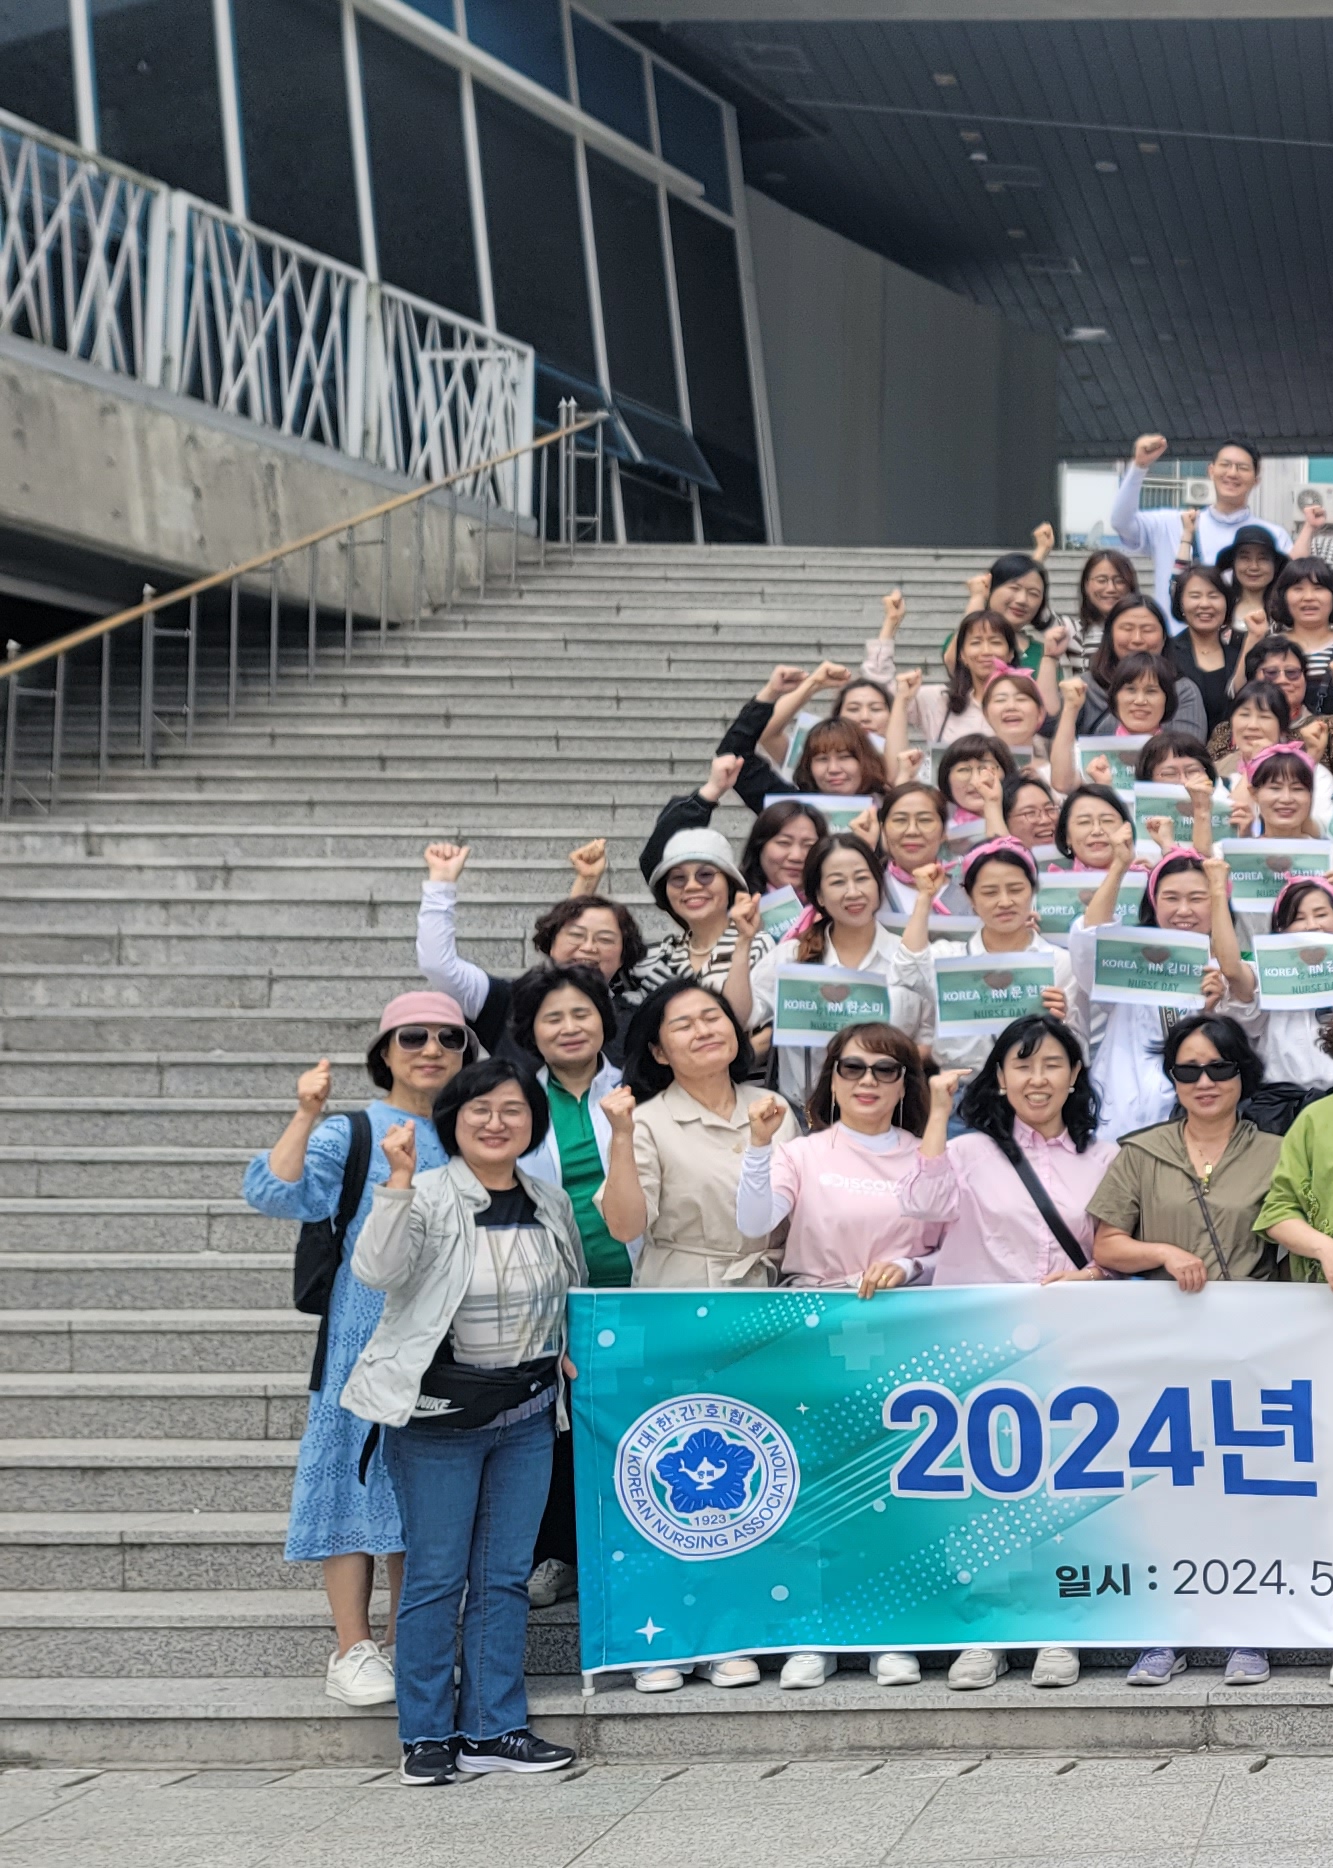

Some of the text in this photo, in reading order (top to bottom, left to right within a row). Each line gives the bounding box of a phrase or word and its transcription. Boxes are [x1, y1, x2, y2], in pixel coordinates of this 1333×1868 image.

[1230, 872, 1264, 880] KOREA
[1041, 905, 1076, 915] KOREA
[1101, 959, 1138, 970] KOREA
[1148, 962, 1164, 973] RN
[1264, 966, 1300, 977] KOREA
[1308, 964, 1324, 974] RN
[943, 990, 981, 1002] KOREA
[991, 987, 1008, 999] RN
[783, 999, 818, 1011] KOREA
[827, 1001, 844, 1013] RN
[417, 1395, 451, 1411] NIKE
[637, 1404, 767, 1449] 대한간호협회
[885, 1378, 1319, 1498] 2024년
[627, 1444, 788, 1549] KOREAN NURSING ASSOCIATION
[694, 1514, 727, 1526] 1923
[1055, 1563, 1133, 1598] 일시
[1172, 1558, 1296, 1596] 2024.
